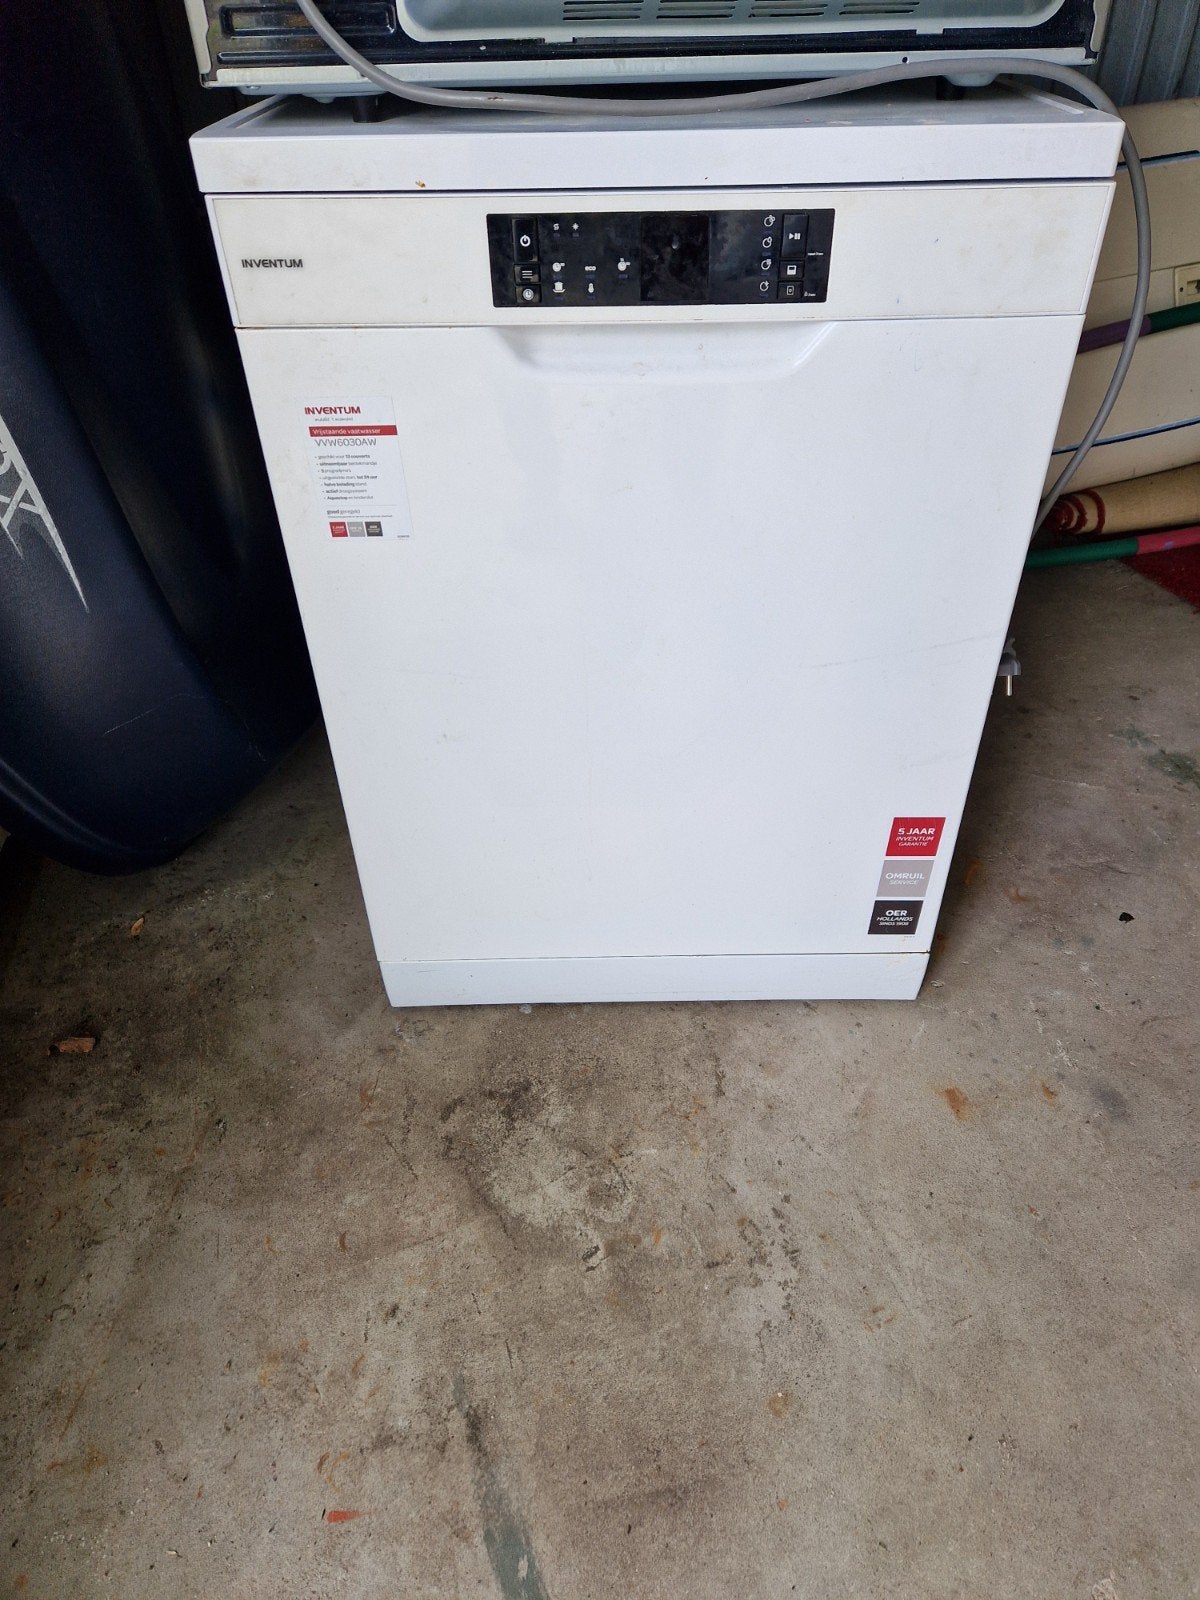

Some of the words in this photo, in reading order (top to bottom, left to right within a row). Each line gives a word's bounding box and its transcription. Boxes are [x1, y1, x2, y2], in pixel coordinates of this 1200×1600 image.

[241, 259, 304, 268] INVENTUM
[304, 406, 361, 414] INVENTUM
[315, 438, 376, 446] VVW6030AW
